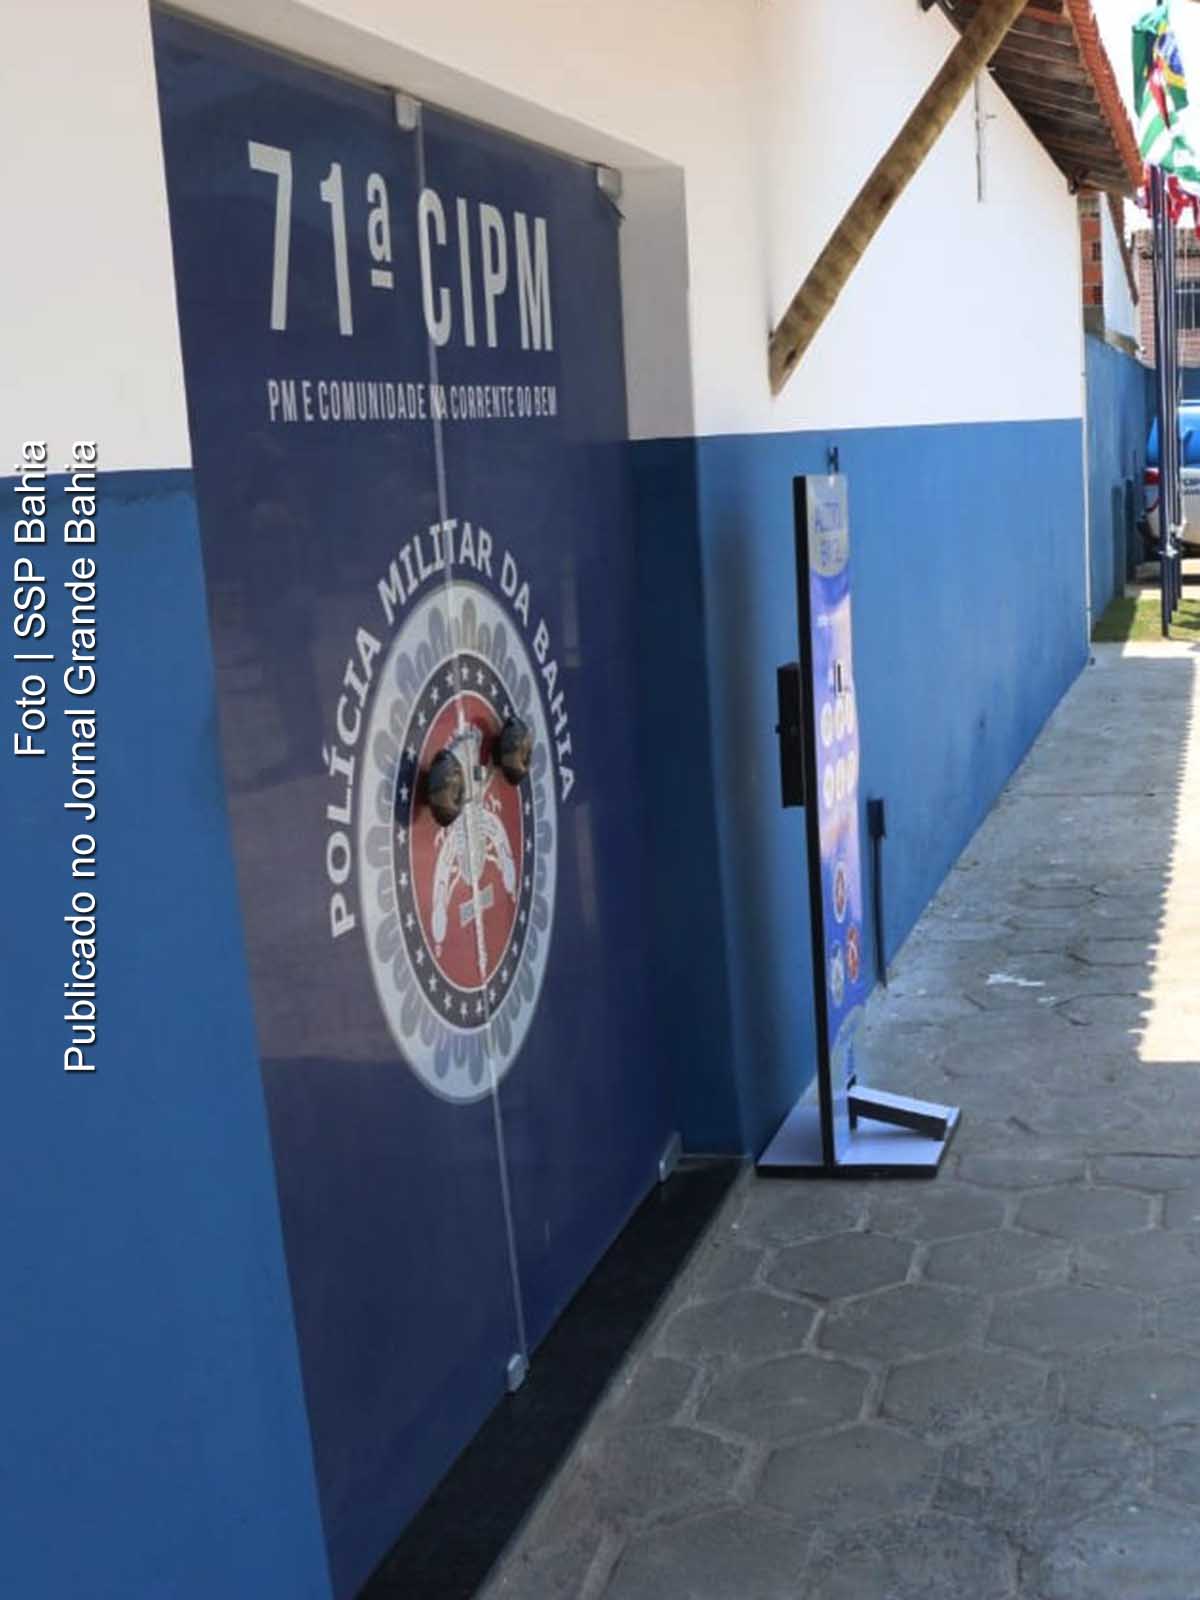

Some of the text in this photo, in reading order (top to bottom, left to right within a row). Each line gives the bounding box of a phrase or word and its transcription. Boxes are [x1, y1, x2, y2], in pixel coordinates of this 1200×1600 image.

[417, 187, 553, 351] CIPM
[268, 379, 558, 422] PM E COMUNIDADE NA CORRENTE DO BEM
[323, 518, 576, 939] POLÍCIA MILITAR DA BAHIA
